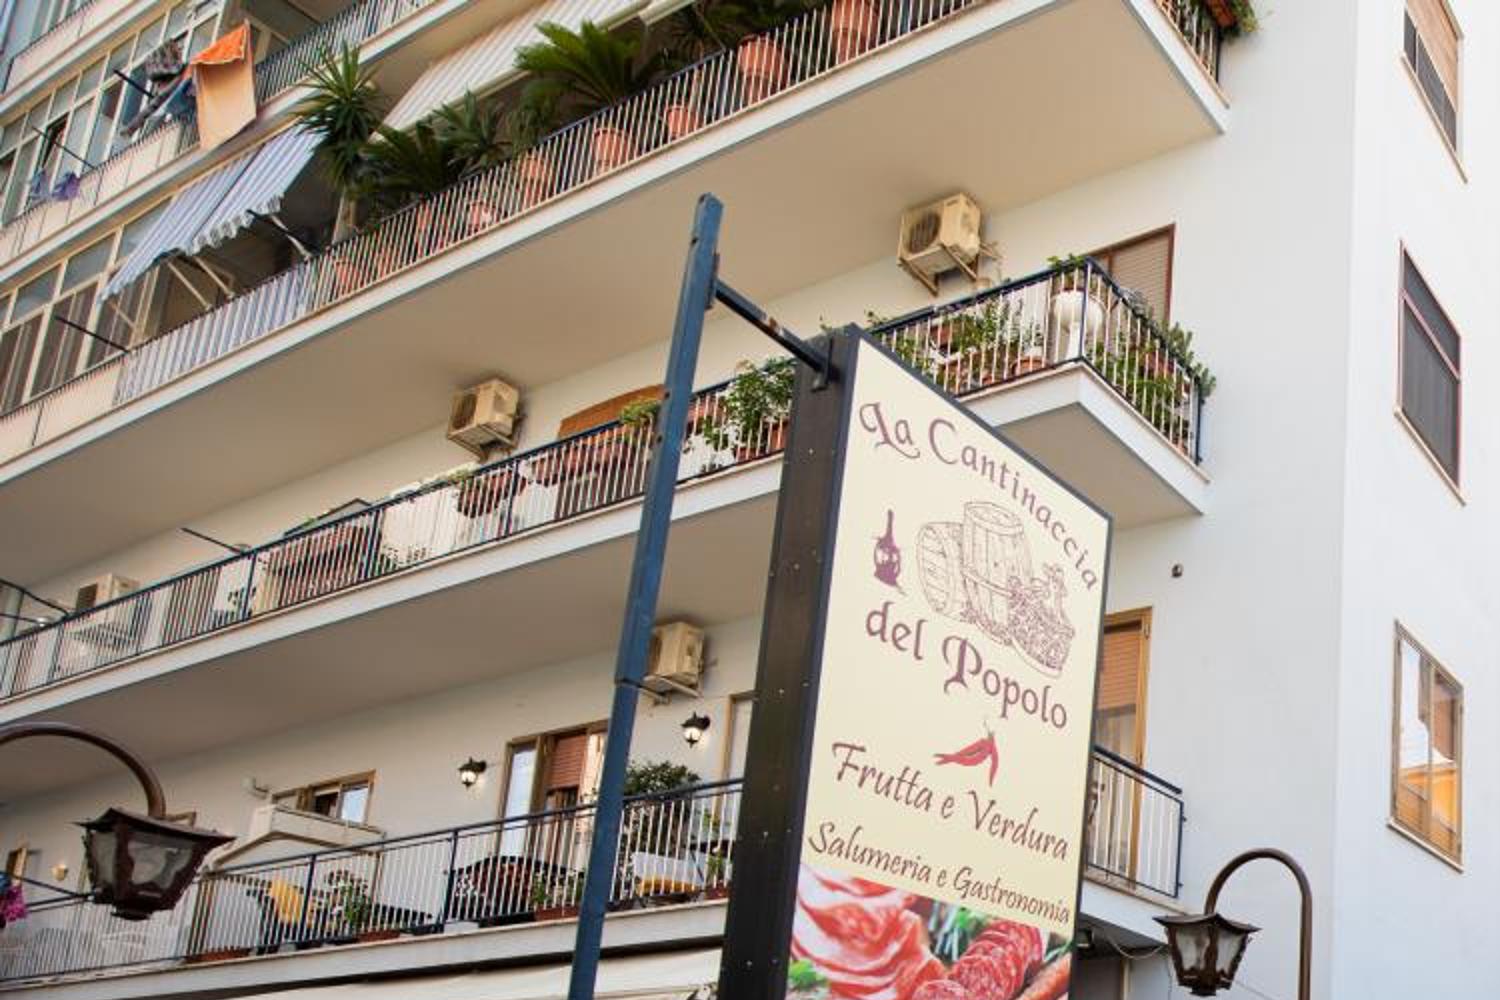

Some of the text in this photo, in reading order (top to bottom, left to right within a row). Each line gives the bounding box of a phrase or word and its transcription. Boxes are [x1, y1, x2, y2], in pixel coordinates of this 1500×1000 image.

[859, 402, 1099, 591] La Cantinaccia
[865, 601, 1068, 730] del Popolo
[831, 741, 1070, 860] Frutta e Verdura
[808, 821, 1070, 923] Salumeria e Gastronomia
